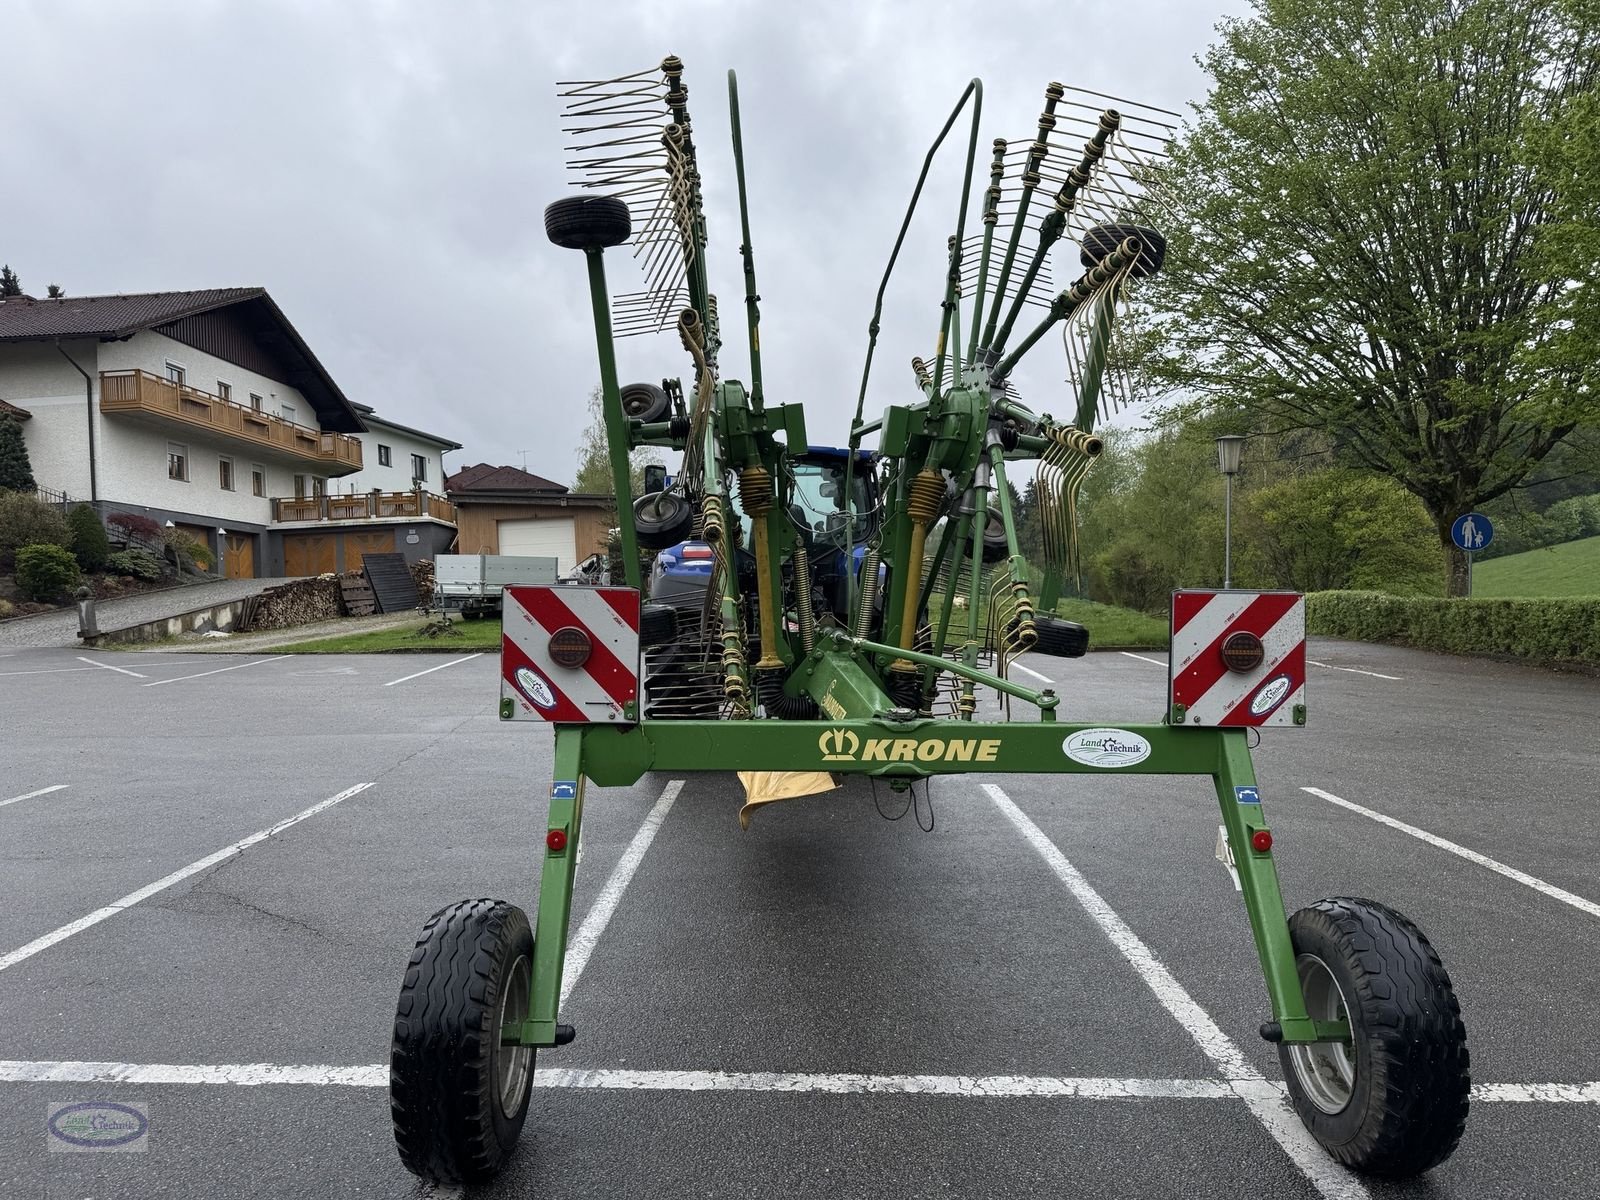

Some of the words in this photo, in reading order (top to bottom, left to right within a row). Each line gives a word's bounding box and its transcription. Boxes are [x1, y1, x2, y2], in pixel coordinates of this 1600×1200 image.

[861, 739, 1001, 761] KRONE
[1080, 738, 1102, 747] Land
[1109, 744, 1141, 753] Technik
